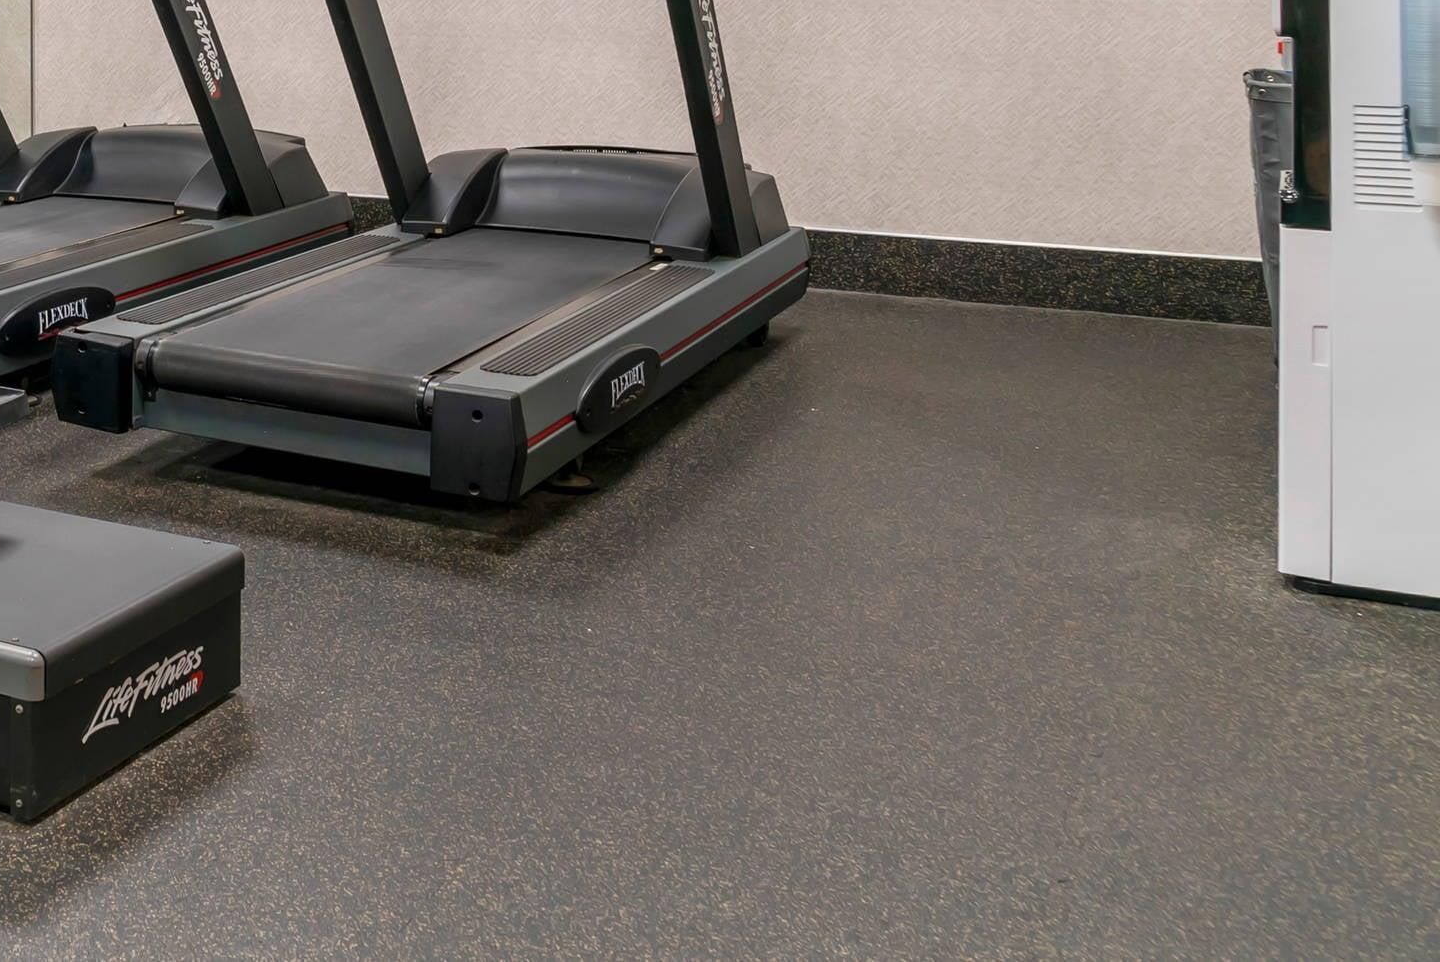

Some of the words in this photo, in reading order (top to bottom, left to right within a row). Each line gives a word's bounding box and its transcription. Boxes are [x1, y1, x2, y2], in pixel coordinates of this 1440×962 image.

[197, 52, 217, 96] 9500HR
[38, 297, 89, 335] FLEXDECK
[611, 360, 645, 408] FLEXDECK
[160, 677, 198, 714] 9500HR
